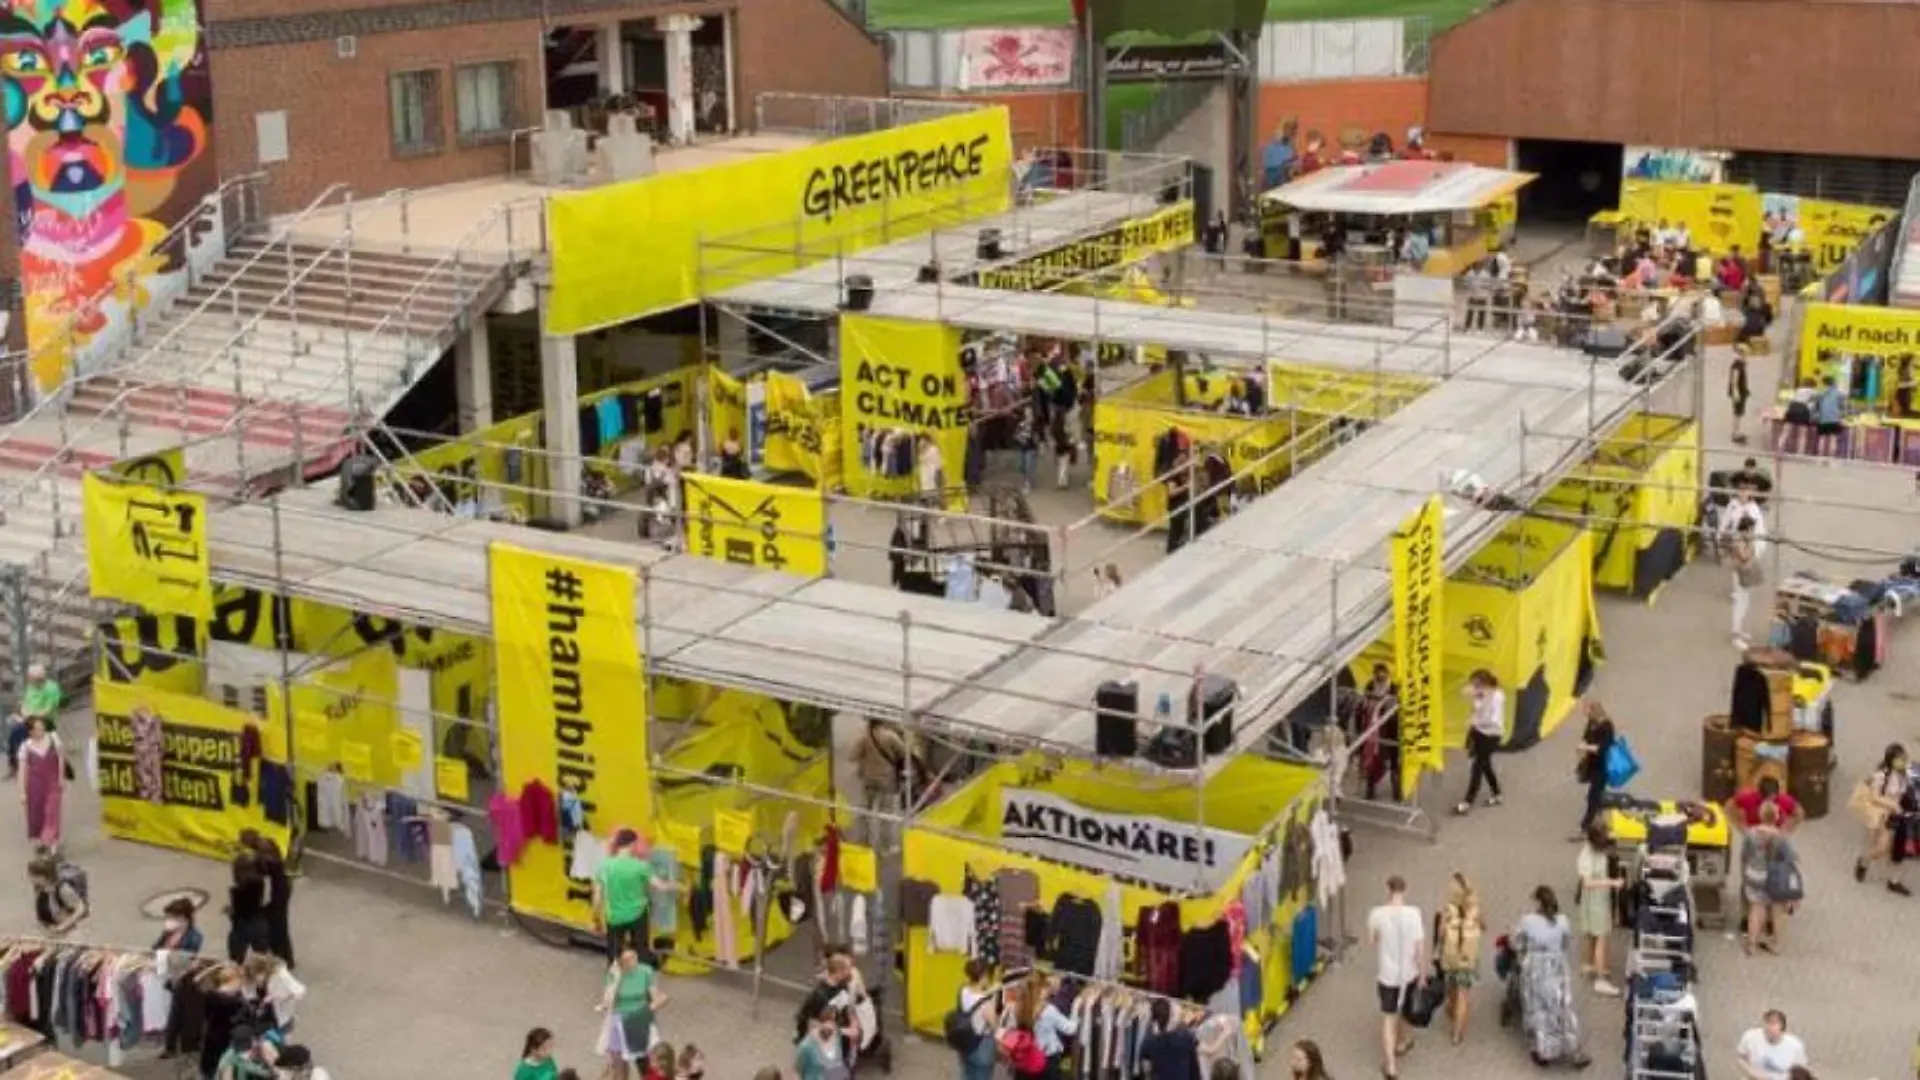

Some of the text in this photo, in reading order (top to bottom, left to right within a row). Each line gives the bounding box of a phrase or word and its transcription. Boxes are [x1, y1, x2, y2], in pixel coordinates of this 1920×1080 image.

[804, 134, 988, 224] GREENPEACE
[1817, 322, 1851, 340] Auf
[1858, 326, 1909, 344] nach
[857, 360, 956, 398] ACT ON
[857, 391, 969, 429] CLIMATE
[163, 731, 240, 764] oppen!
[546, 566, 597, 906] #hambibt
[96, 762, 134, 795] ald
[1003, 799, 1217, 868] AKTIONÄRE!
